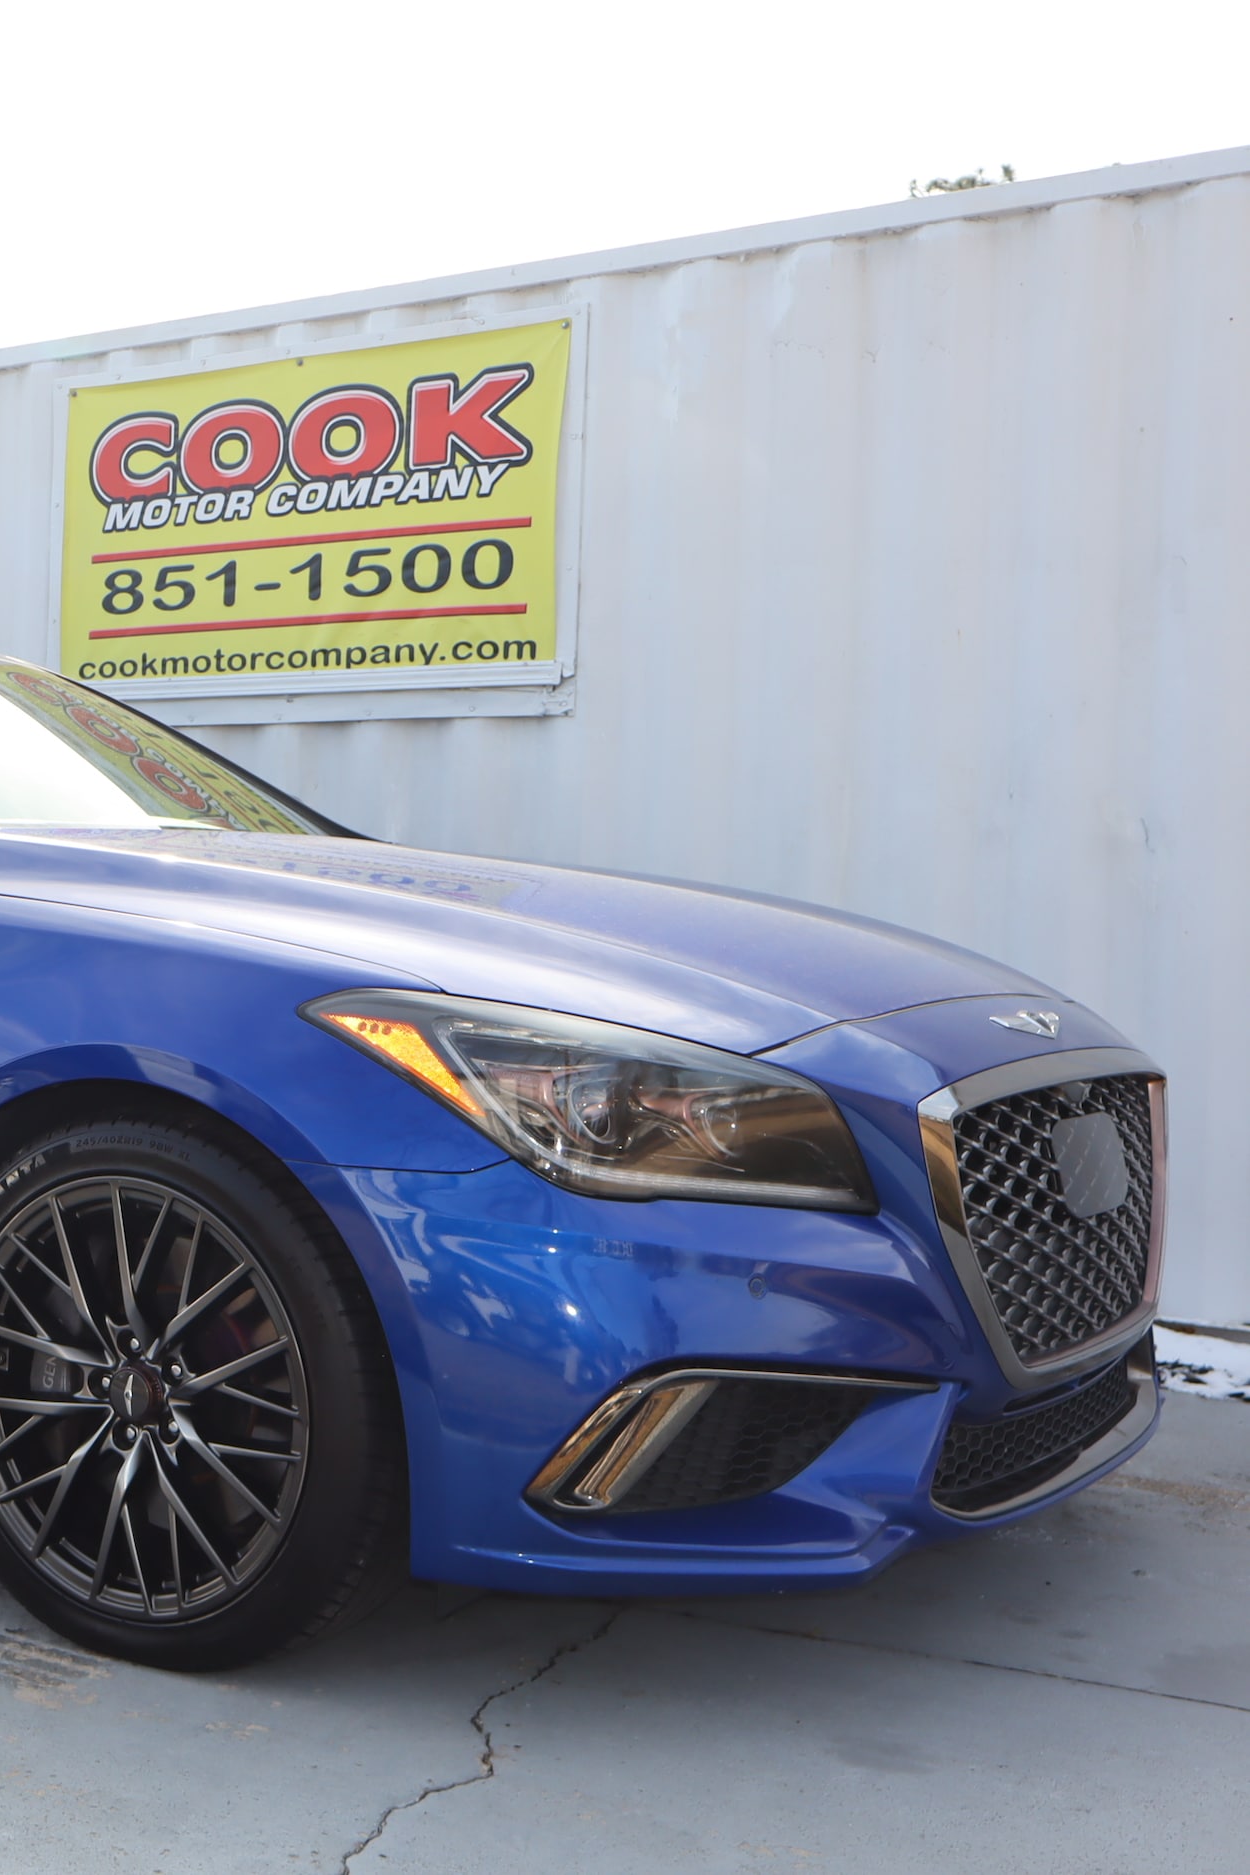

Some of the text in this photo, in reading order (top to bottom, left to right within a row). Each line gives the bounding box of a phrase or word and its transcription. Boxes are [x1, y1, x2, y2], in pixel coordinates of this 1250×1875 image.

[89, 362, 534, 506] COOK
[103, 462, 509, 533] MOTOR COMPANY
[101, 539, 514, 616] 851-1500
[78, 638, 537, 680] cookmotorcompany.com
